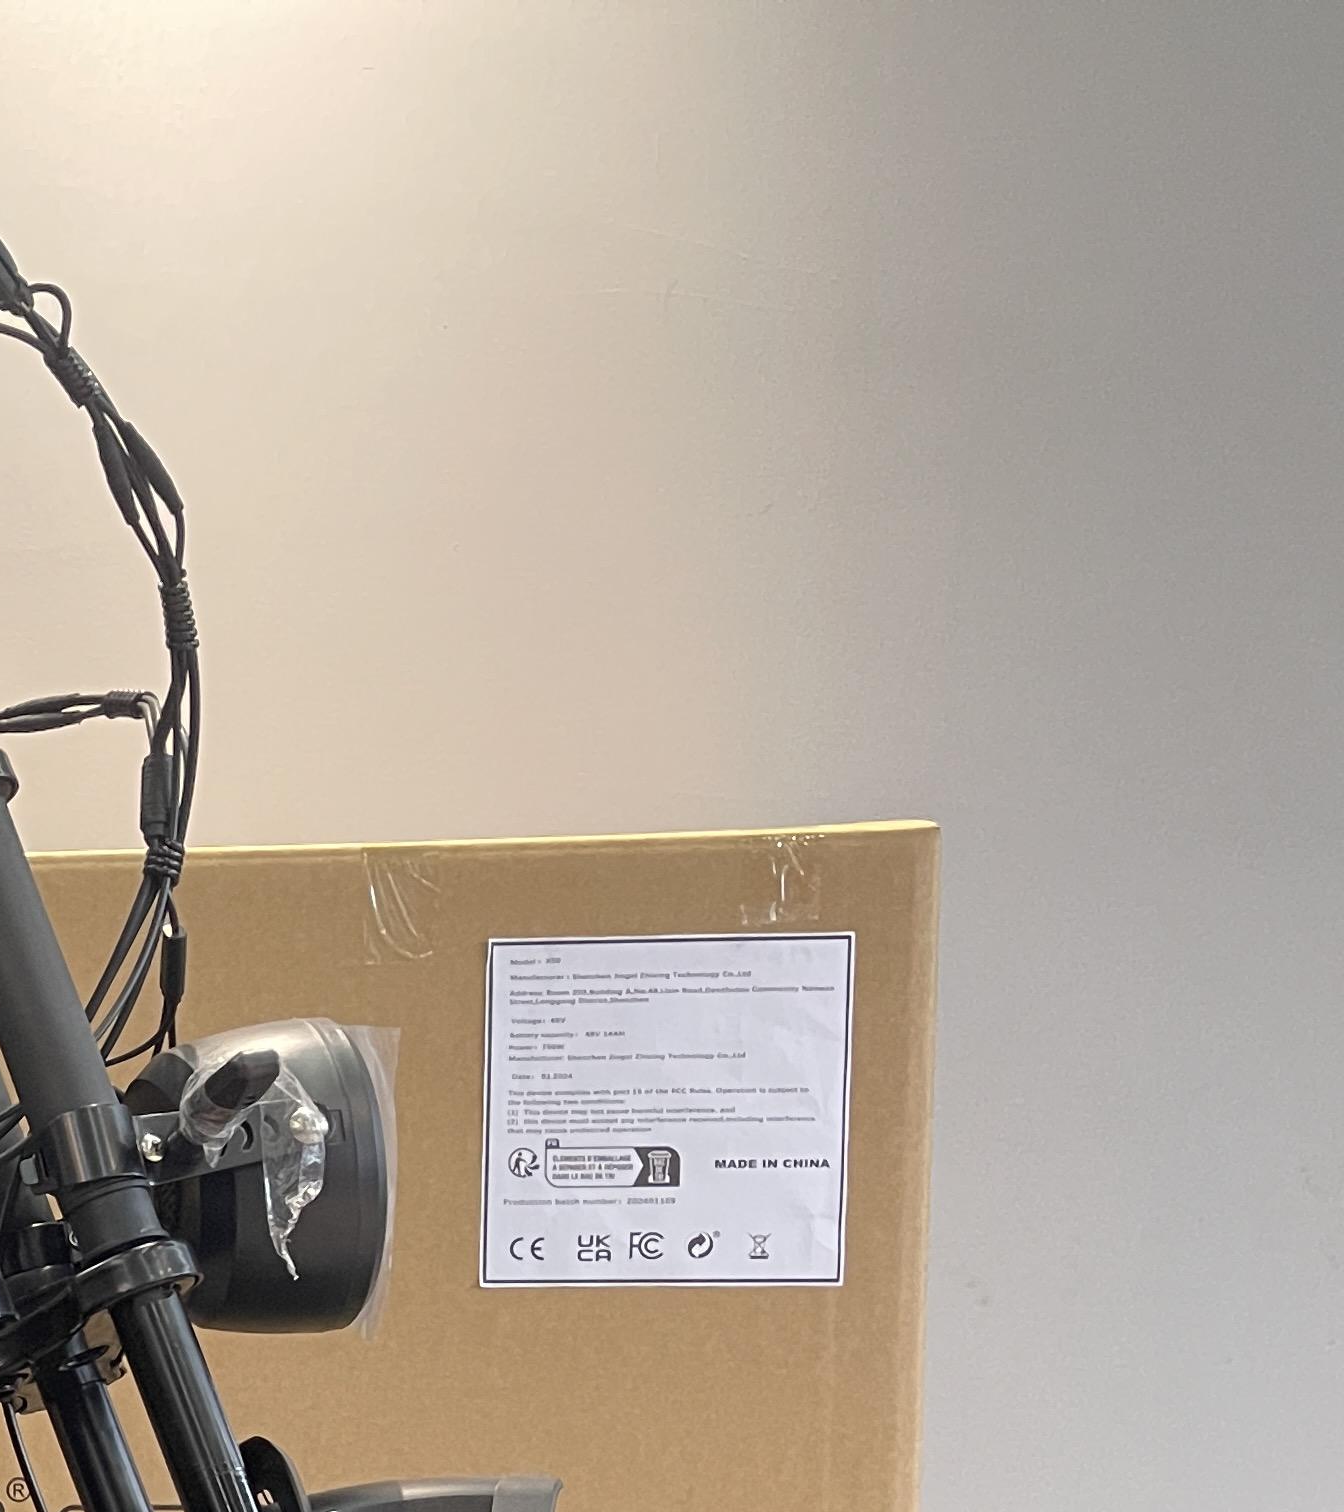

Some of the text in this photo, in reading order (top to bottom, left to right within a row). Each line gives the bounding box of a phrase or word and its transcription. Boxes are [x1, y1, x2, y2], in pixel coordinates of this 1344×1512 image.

[714, 1158, 831, 1170] MADE IN CHINA
[578, 1235, 611, 1247] UK
